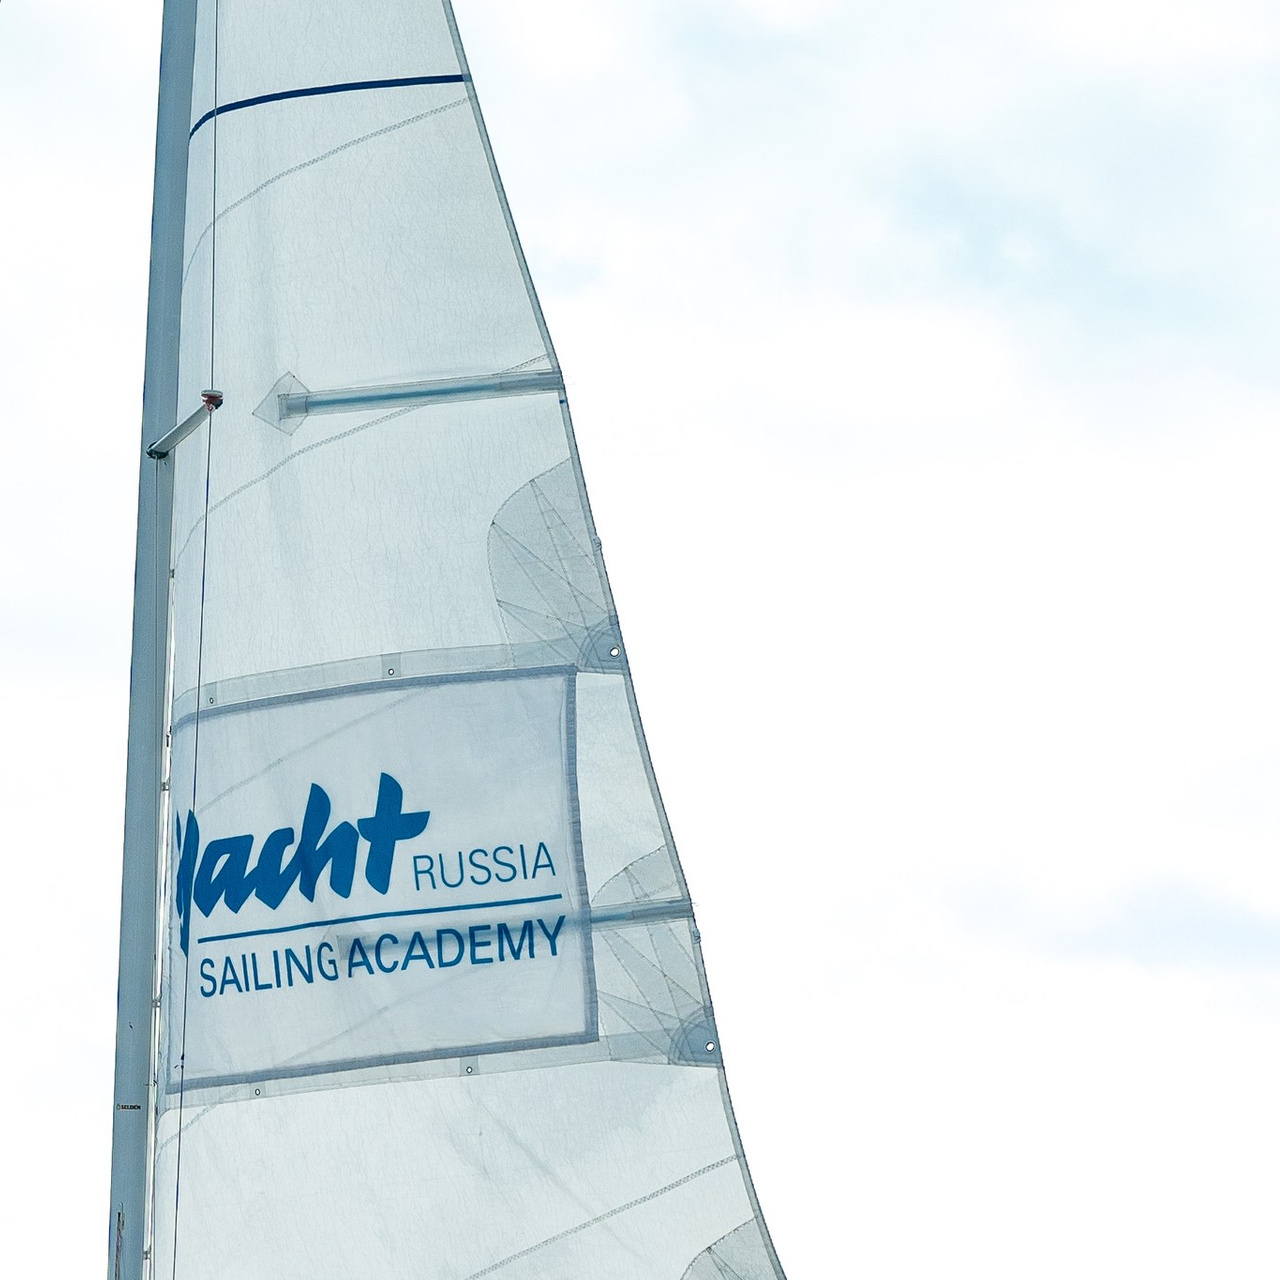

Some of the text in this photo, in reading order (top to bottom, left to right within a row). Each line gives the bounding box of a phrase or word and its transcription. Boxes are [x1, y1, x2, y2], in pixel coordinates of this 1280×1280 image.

[412, 841, 557, 892] RUSSIA
[199, 915, 566, 998] SAILING ACADEMY
